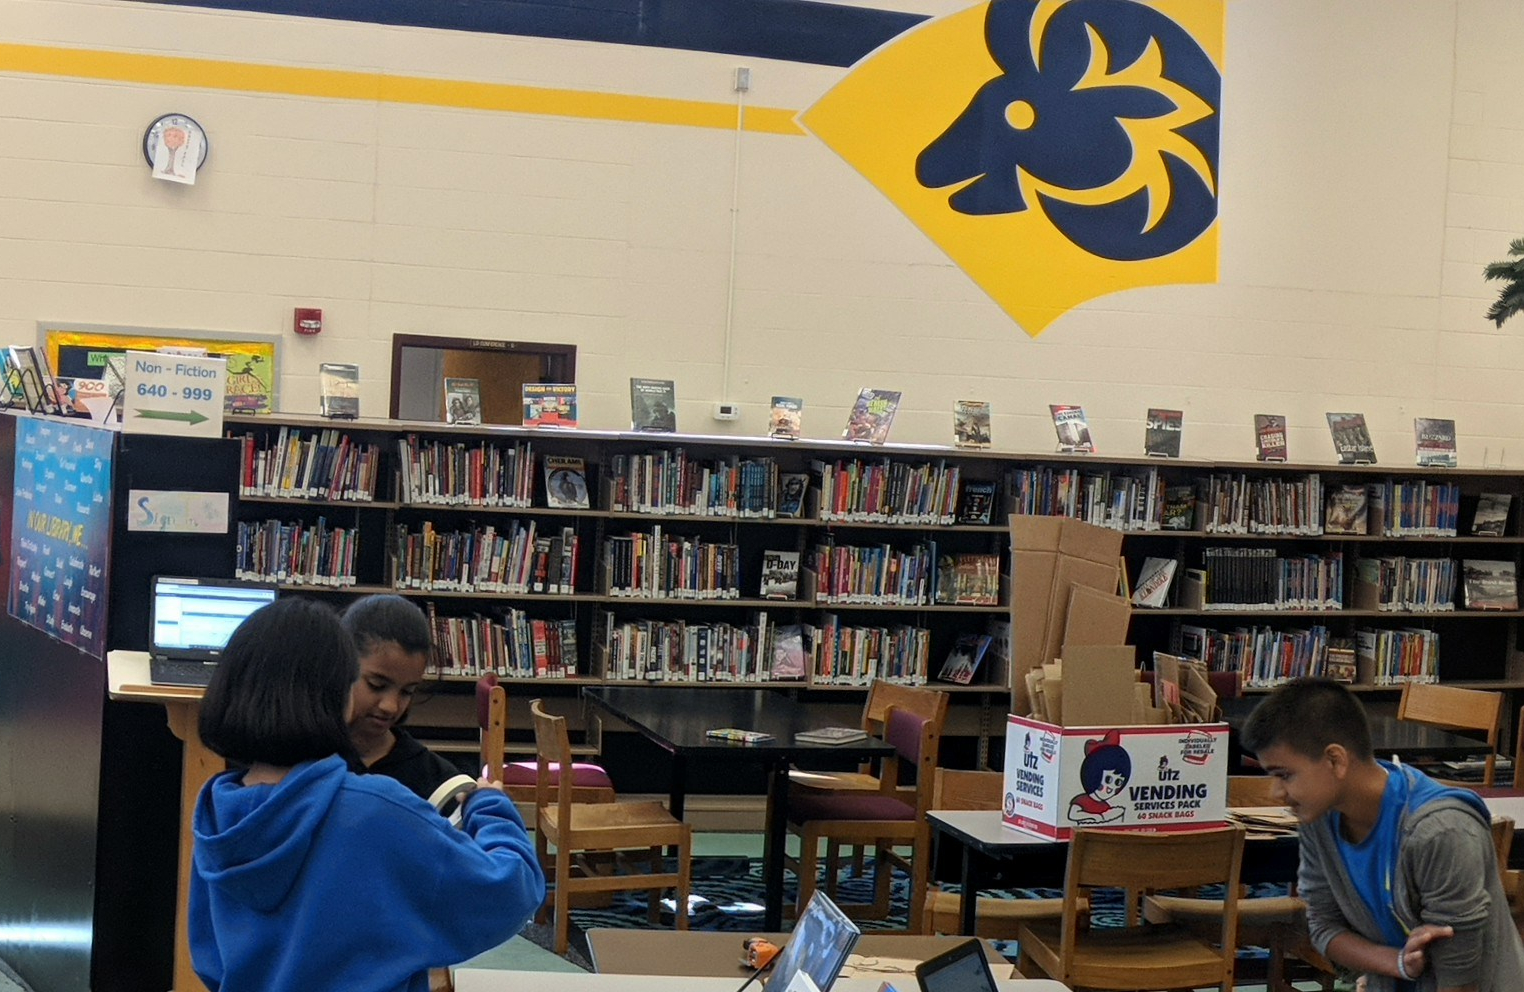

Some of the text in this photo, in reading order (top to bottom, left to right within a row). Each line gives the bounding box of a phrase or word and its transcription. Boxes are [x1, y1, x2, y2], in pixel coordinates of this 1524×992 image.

[135, 360, 162, 374] Non
[175, 363, 217, 379] Fiction
[137, 383, 167, 397] 640
[182, 386, 213, 401] 999
[1016, 768, 1044, 786] VENDING
[1016, 781, 1044, 798] SERVICES
[1129, 783, 1207, 801] VENDING
[1134, 800, 1201, 811] SERVICES PACK
[1137, 812, 1146, 820] 60
[1148, 811, 1173, 820] SNACK
